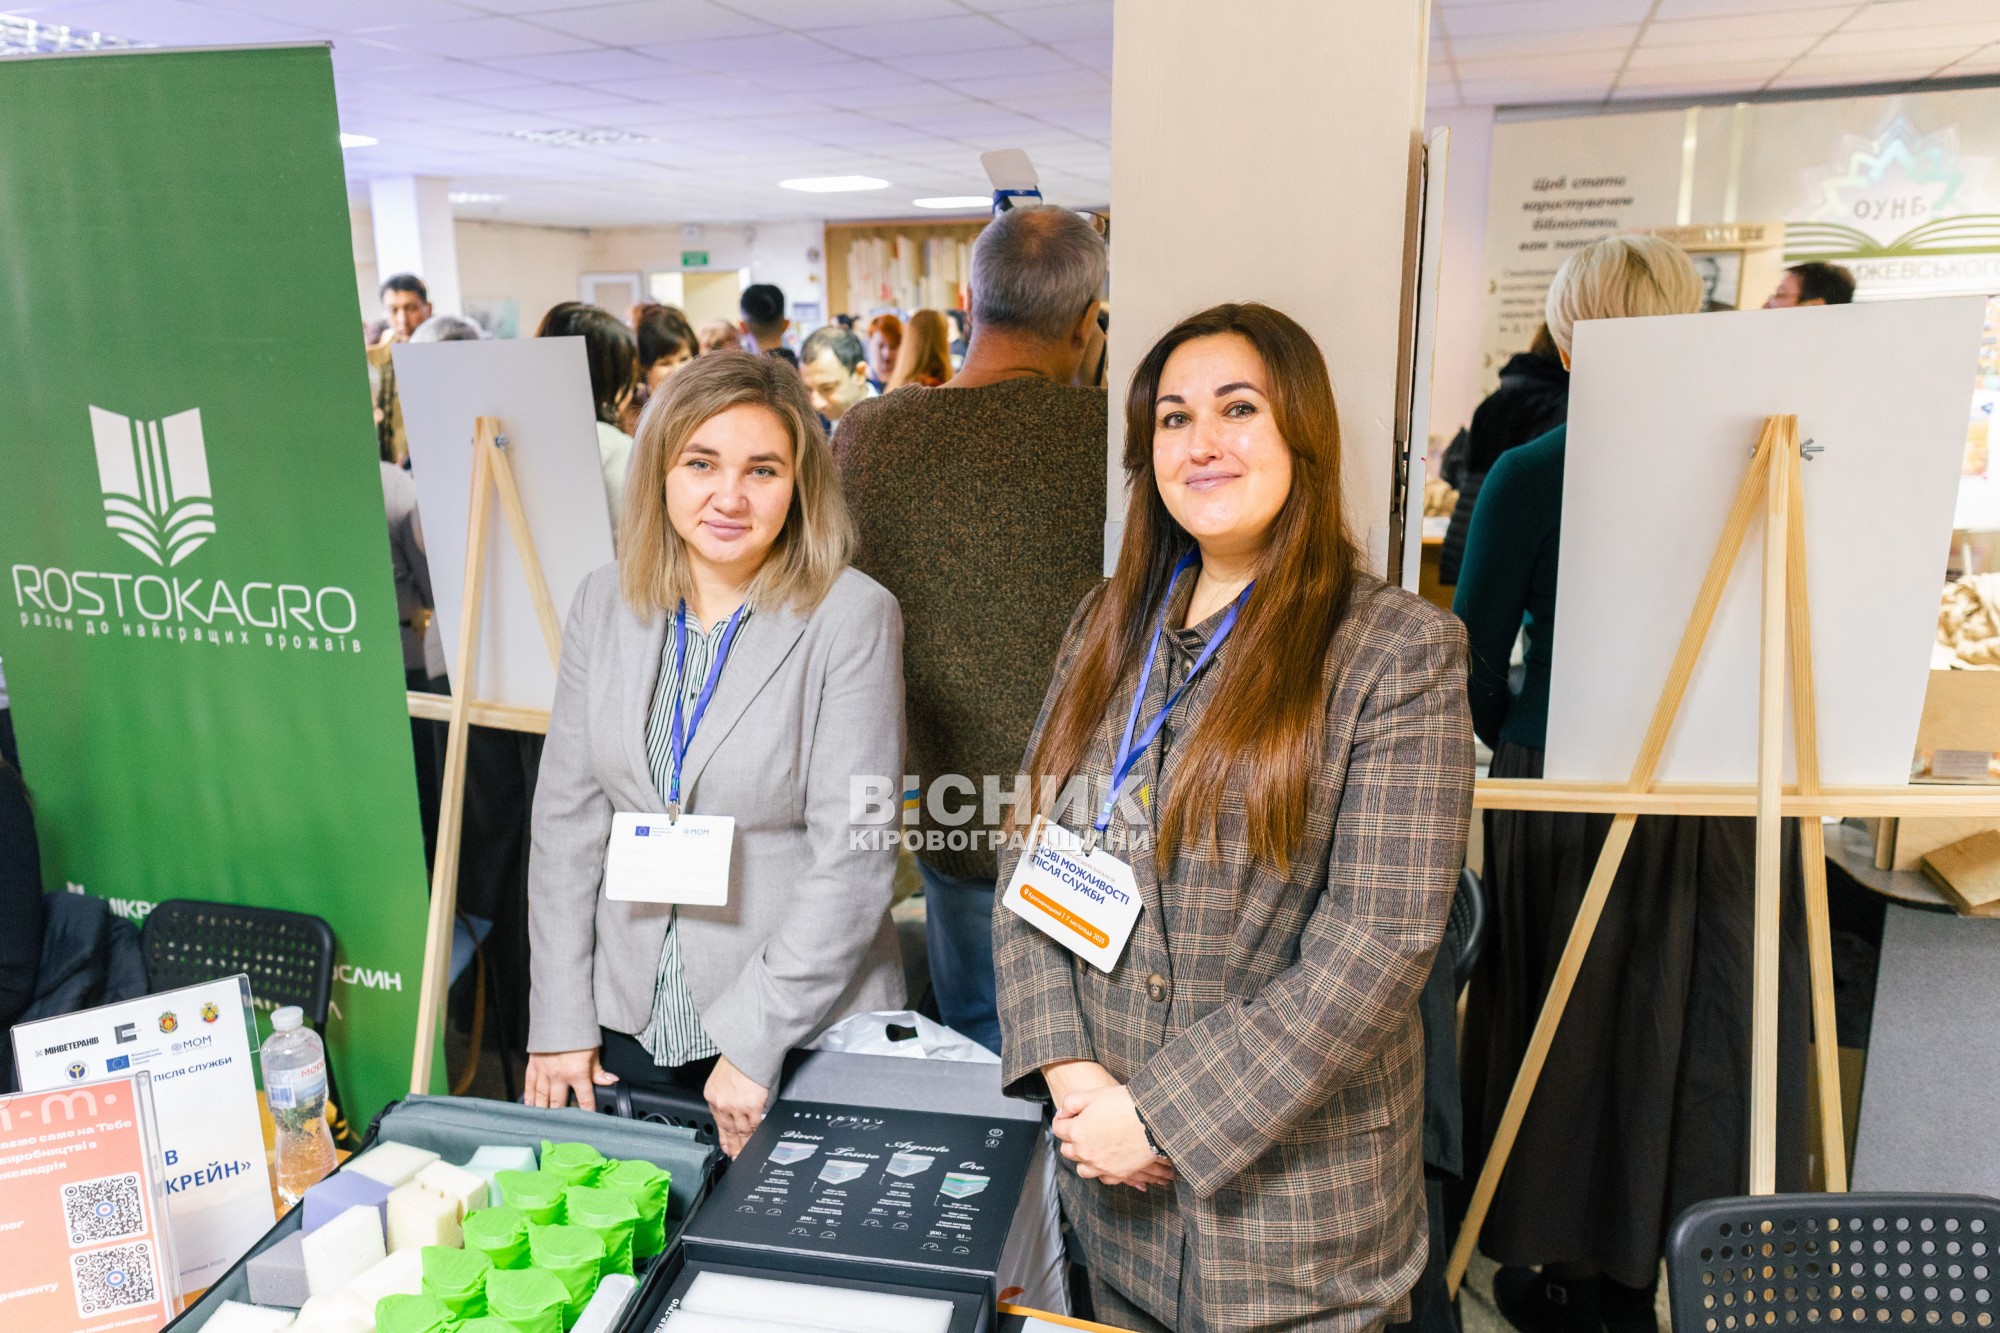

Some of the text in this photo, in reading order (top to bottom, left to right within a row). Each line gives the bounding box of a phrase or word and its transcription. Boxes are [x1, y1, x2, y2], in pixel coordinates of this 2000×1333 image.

[1853, 196, 1928, 220] ОУНБ
[12, 564, 358, 633] ROSTOKAGRO
[19, 611, 362, 653] разом до найкращих врожаїв
[1032, 854, 1106, 905] ПІСЛЯ СЛУЖБИ
[1036, 844, 1131, 906] НОВІ МОЖЛИВОСТІ
[44, 1036, 100, 1056] МІНВЕТЕРАНІВ
[183, 1034, 213, 1049] МОМ
[153, 1056, 233, 1083] ПІСЛЯ СЛУЖБИ
